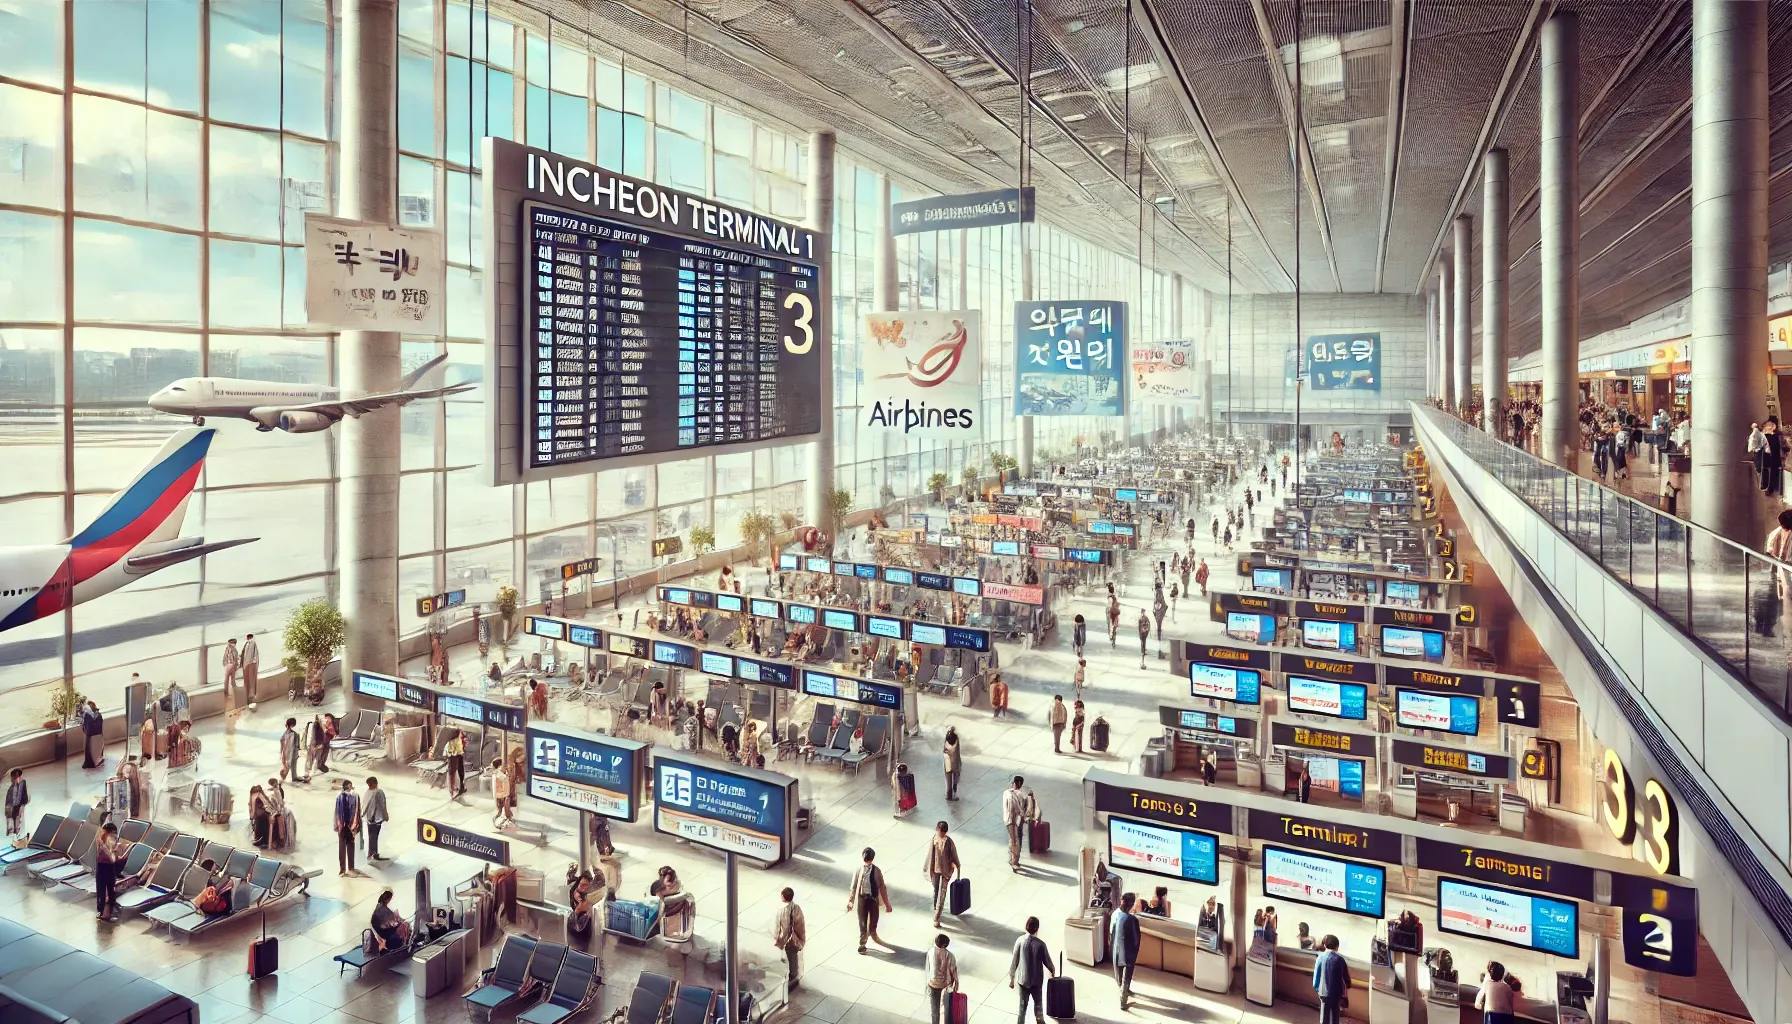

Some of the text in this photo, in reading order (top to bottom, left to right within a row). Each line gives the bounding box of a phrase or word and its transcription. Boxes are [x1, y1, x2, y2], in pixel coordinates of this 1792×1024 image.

[527, 153, 679, 226] INCHEON
[686, 197, 800, 255] TERMINAL
[806, 234, 813, 259] 1
[784, 292, 814, 355] 3
